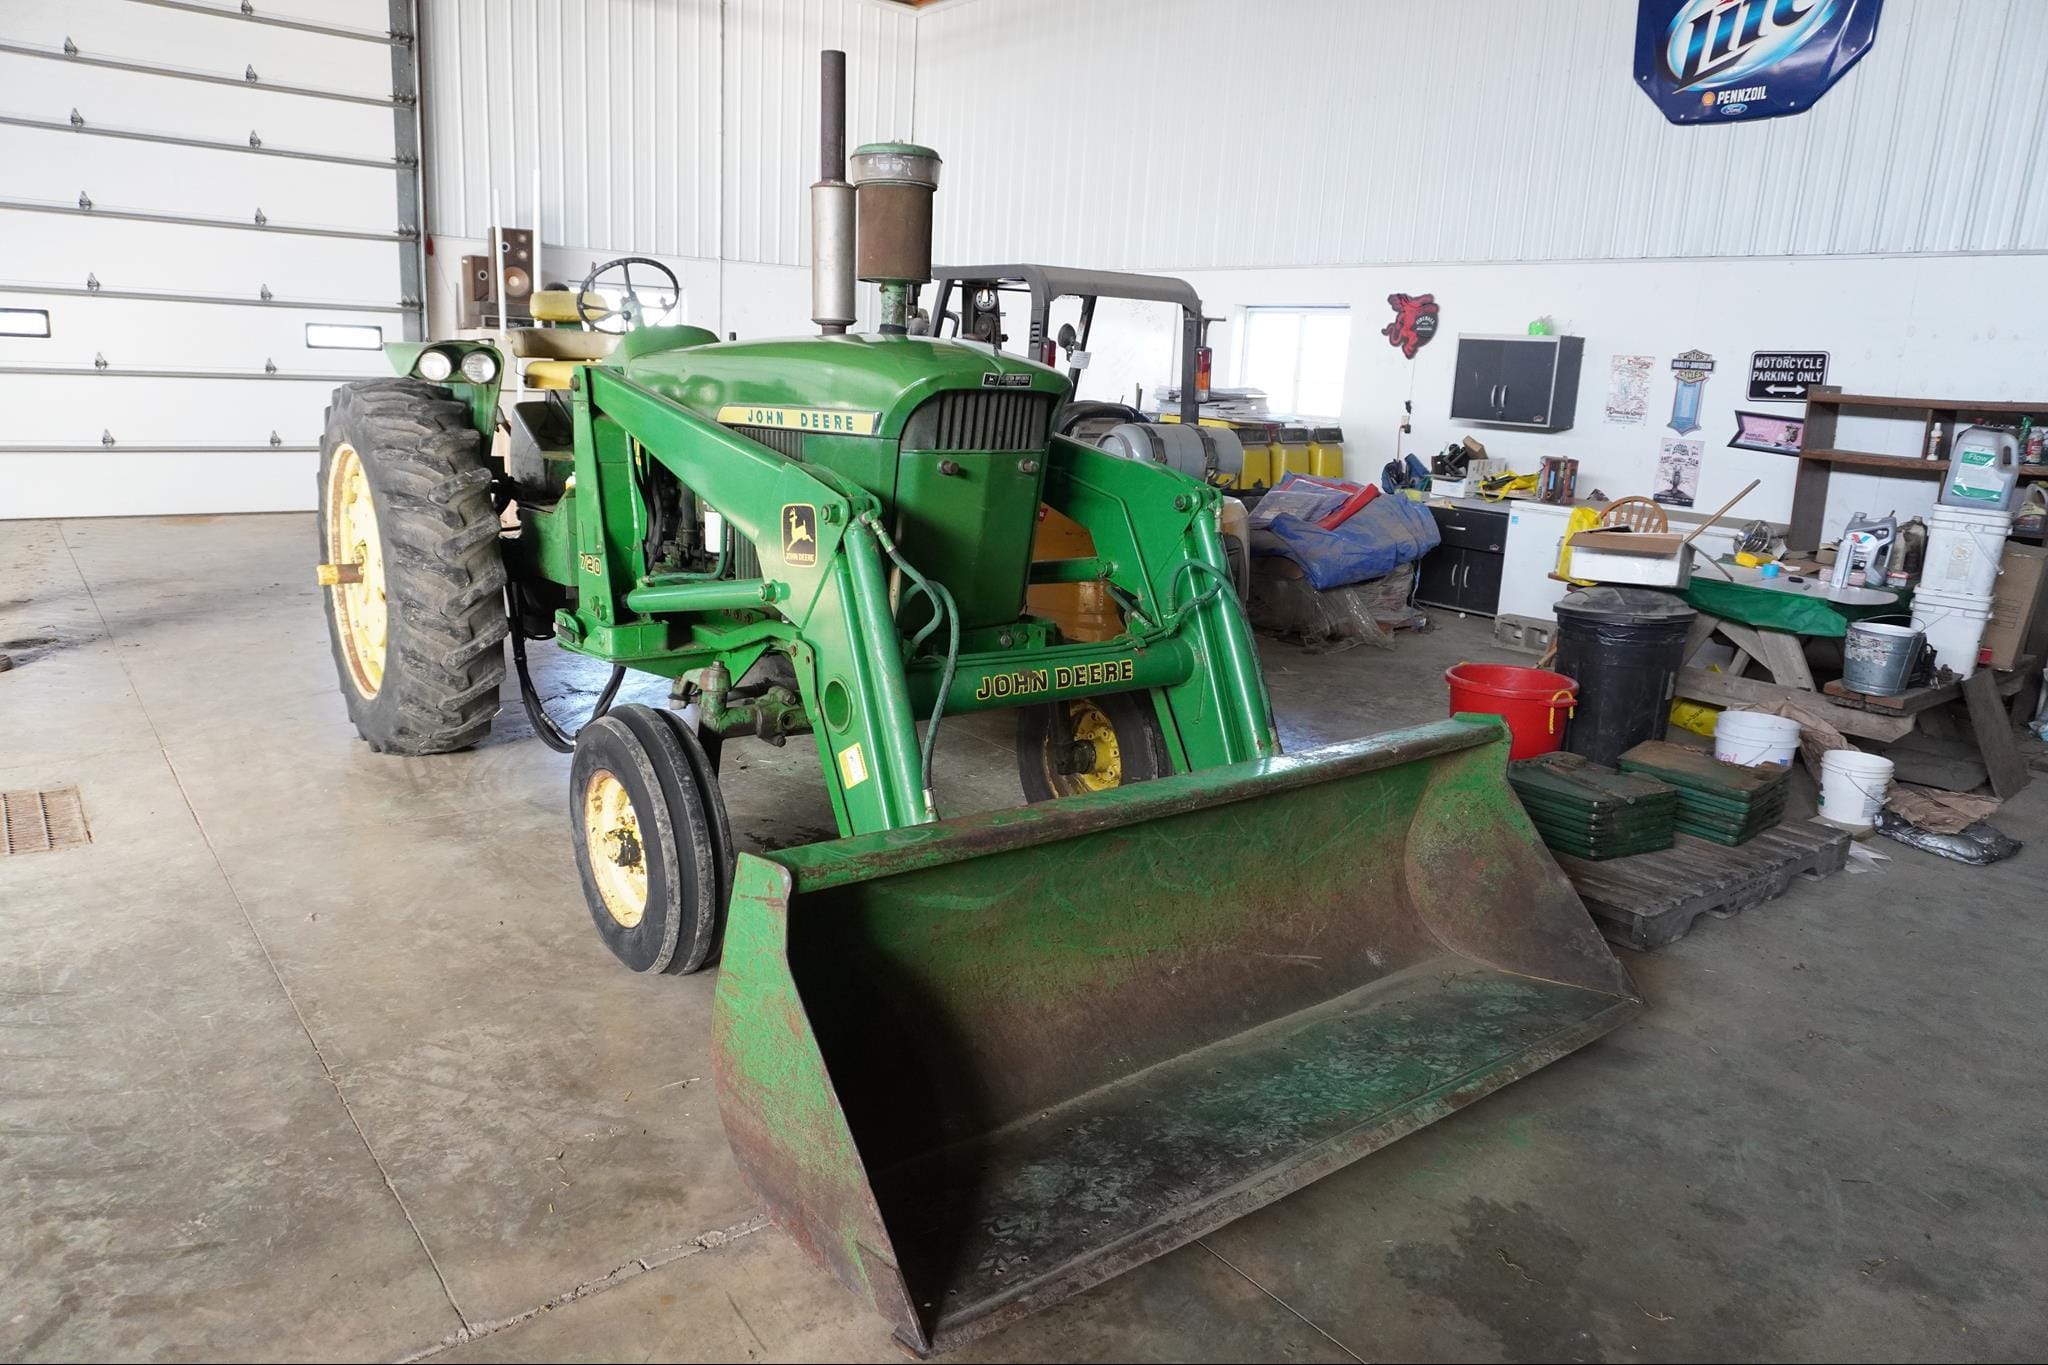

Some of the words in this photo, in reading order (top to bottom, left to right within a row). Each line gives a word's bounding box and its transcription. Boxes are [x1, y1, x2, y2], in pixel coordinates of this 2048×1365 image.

[1716, 86, 1767, 105] PENNZOIL
[1683, 351, 1705, 360] MOTOR
[1755, 357, 1823, 369] MOTORCYCLE
[1752, 371, 1794, 382] PARKING
[1797, 371, 1823, 382] ONLY
[747, 409, 784, 426] JOHN
[800, 412, 854, 431] DEERE
[579, 551, 601, 577] 720
[785, 552, 798, 560] JOHN
[798, 553, 815, 562] DEERE
[976, 669, 1049, 700] JOHN
[1055, 659, 1133, 690] DEERE
